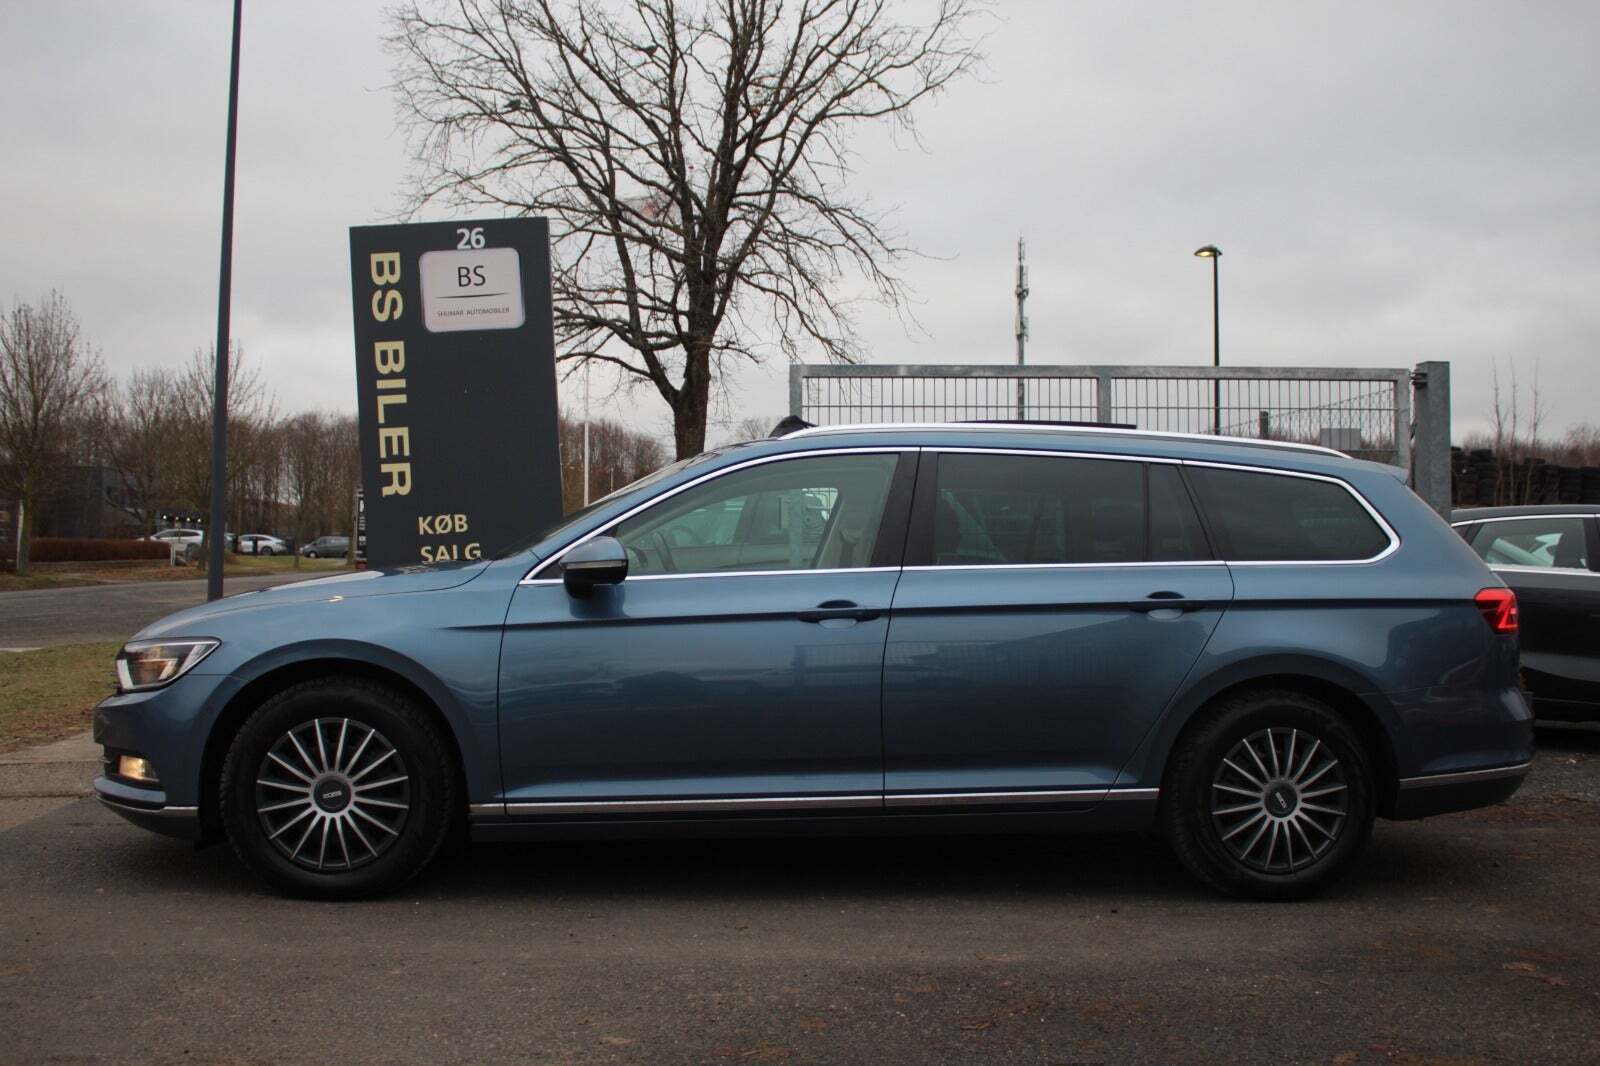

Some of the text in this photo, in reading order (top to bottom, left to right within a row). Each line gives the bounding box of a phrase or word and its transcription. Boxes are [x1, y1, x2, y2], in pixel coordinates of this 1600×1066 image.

[456, 227, 486, 250] 26
[457, 265, 486, 288] BS
[466, 306, 510, 316] AUTOMOBILER
[370, 252, 412, 497] BS BILER
[418, 513, 468, 535] KØB
